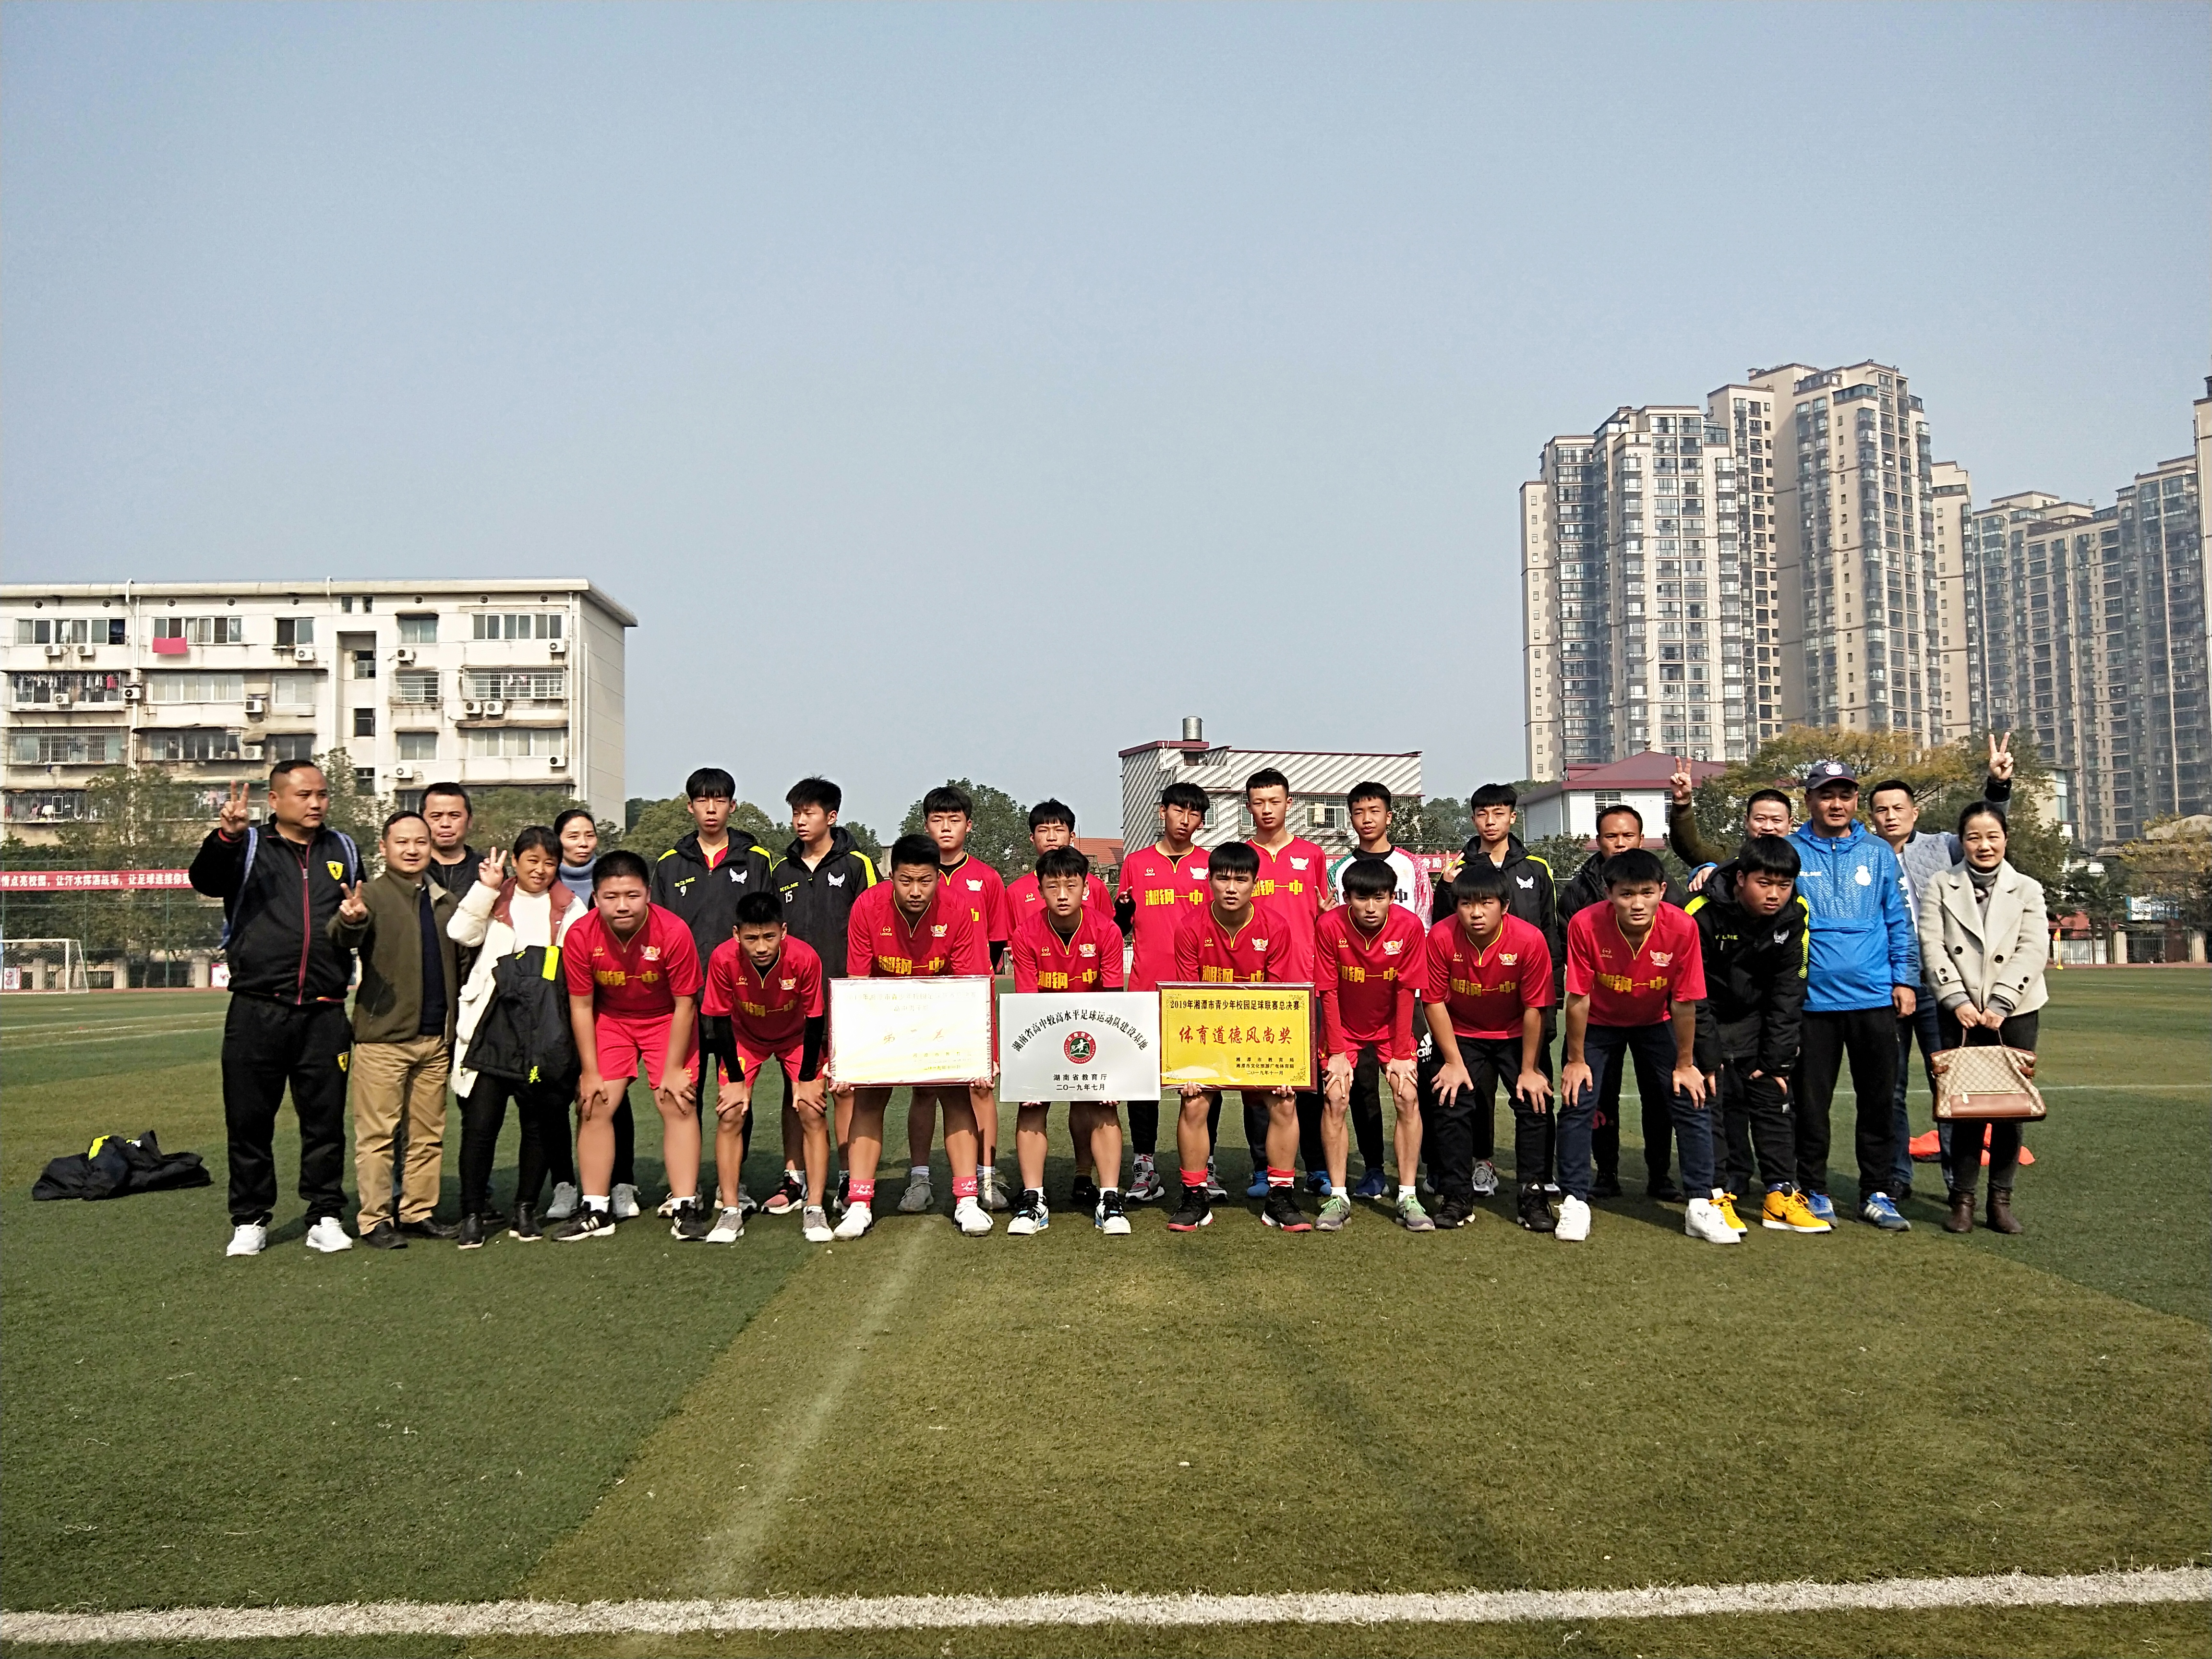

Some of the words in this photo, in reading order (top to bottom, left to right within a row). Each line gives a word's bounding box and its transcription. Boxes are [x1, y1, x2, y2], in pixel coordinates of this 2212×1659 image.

[680, 886, 687, 897] 9
[780, 882, 799, 892] KELME
[784, 890, 793, 903] 15
[1145, 889, 1204, 906] 湘钢一中
[878, 955, 945, 975] 湘钢一中
[1202, 965, 1265, 982] 湘钢一中
[1037, 968, 1097, 989] 湘钢一中
[1171, 999, 1299, 1011] 2019年湘潭市青少年校园足球联赛总决赛
[1011, 1009, 1149, 1053] 湖南省高中较高水平足球运动队建设基地
[1179, 1025, 1292, 1045] 体育道德风尚奖
